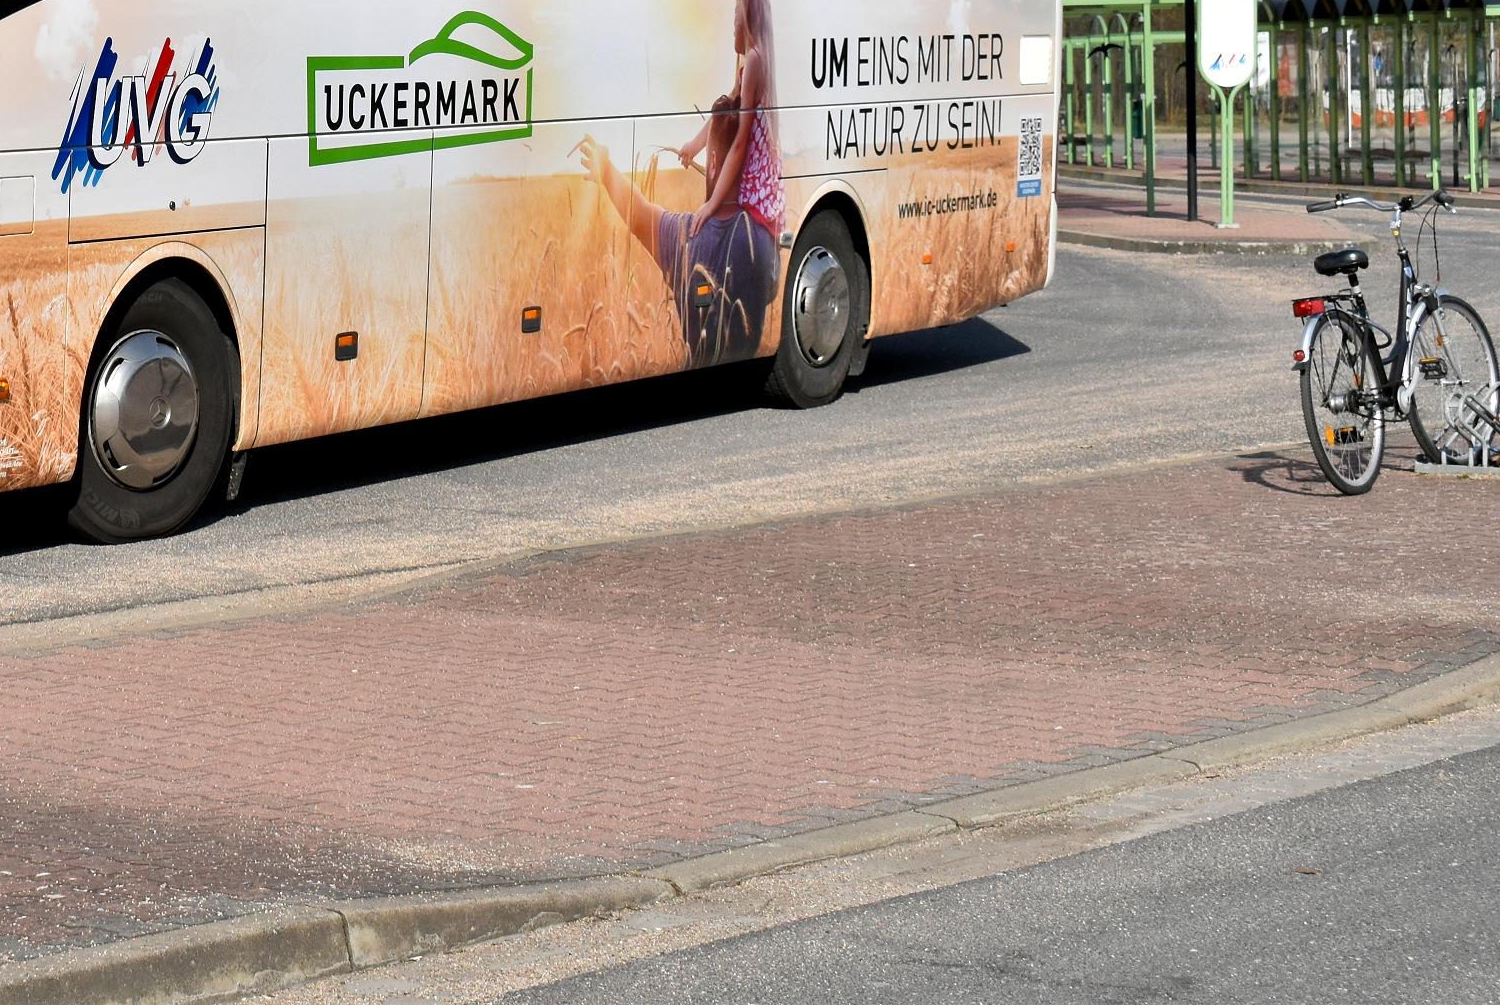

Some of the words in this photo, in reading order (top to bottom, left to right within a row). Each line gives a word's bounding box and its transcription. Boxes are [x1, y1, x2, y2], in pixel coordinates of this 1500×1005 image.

[811, 37, 849, 89] UM
[856, 35, 910, 87] EINS
[917, 34, 955, 84] MIT
[961, 33, 1004, 81] DER
[86, 73, 212, 171] UVG
[324, 78, 520, 131] UCKERMARK
[826, 105, 905, 161] NATUR
[911, 103, 940, 154] ZU
[946, 99, 1002, 151] SEIN!
[898, 188, 998, 219] www.ic-uckermark.de
